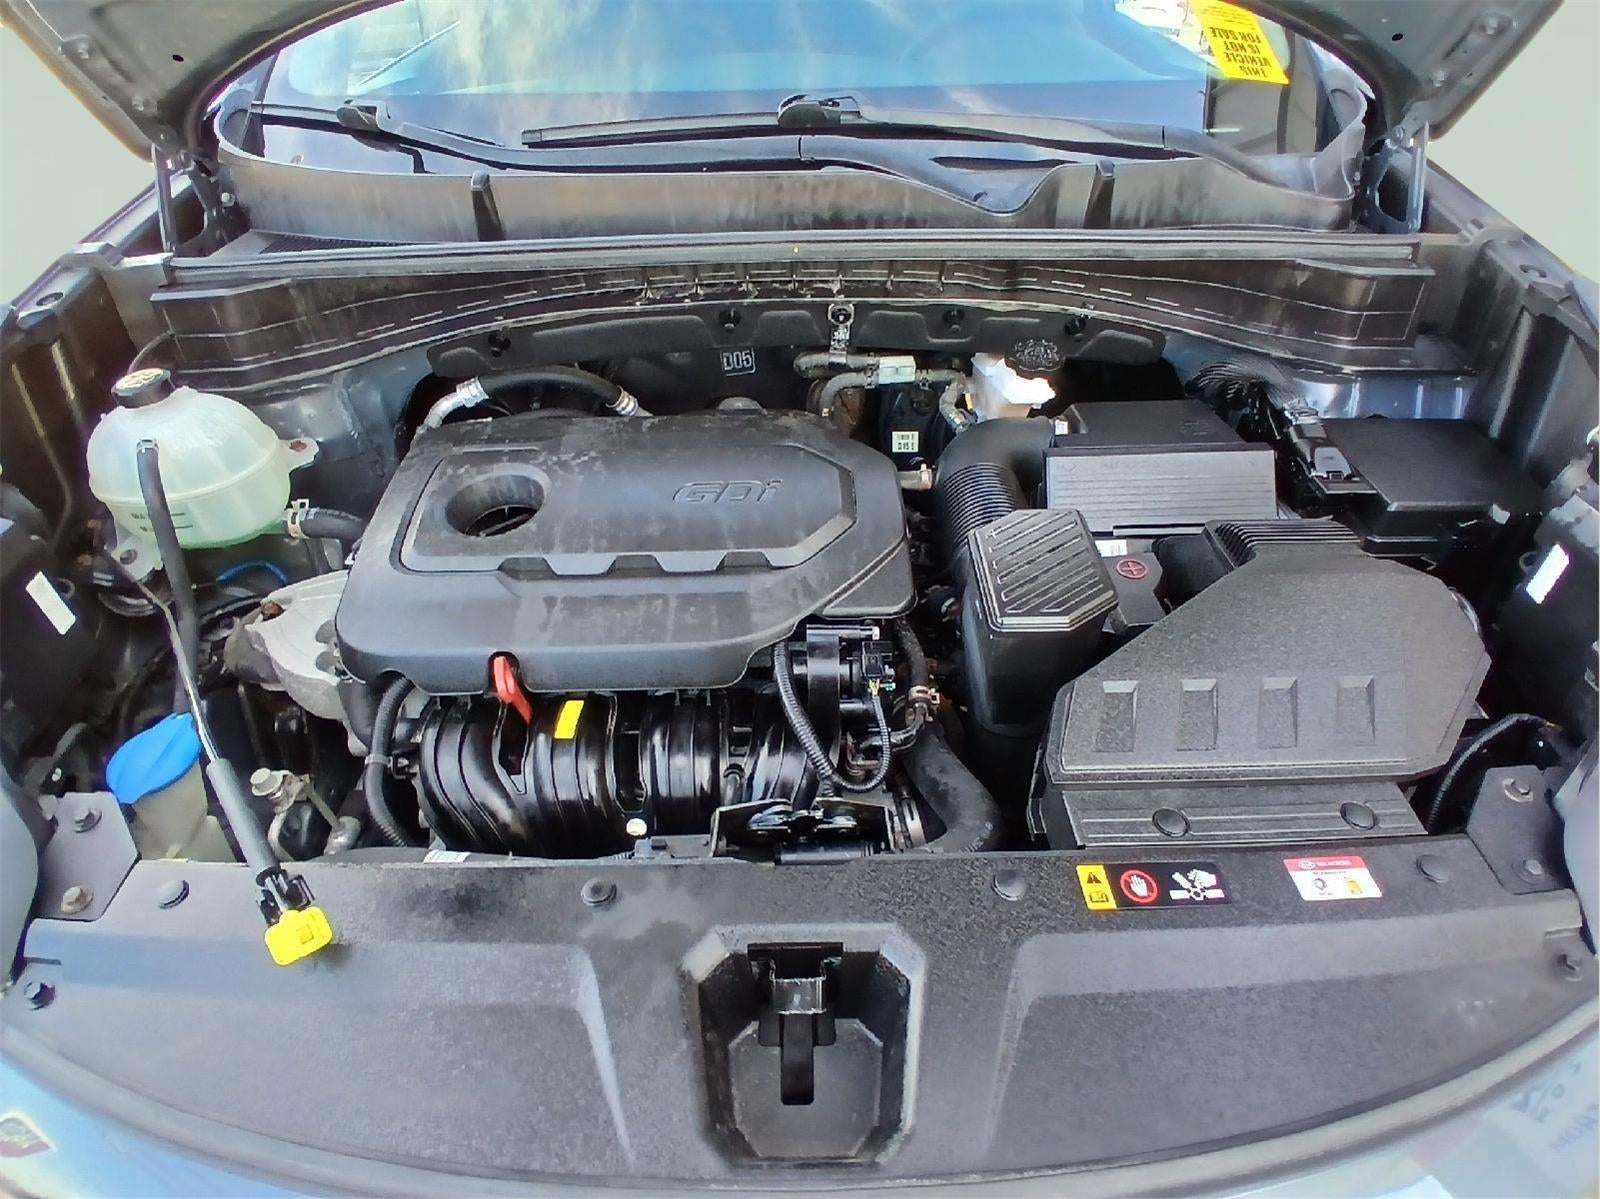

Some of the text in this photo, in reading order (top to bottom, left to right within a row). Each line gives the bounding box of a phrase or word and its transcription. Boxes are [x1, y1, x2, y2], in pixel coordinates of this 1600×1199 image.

[1209, 26, 1262, 43] FOR SALE
[1223, 41, 1261, 55] IS NOT
[1224, 51, 1272, 67] VEHICLE
[1239, 65, 1268, 78] THIS
